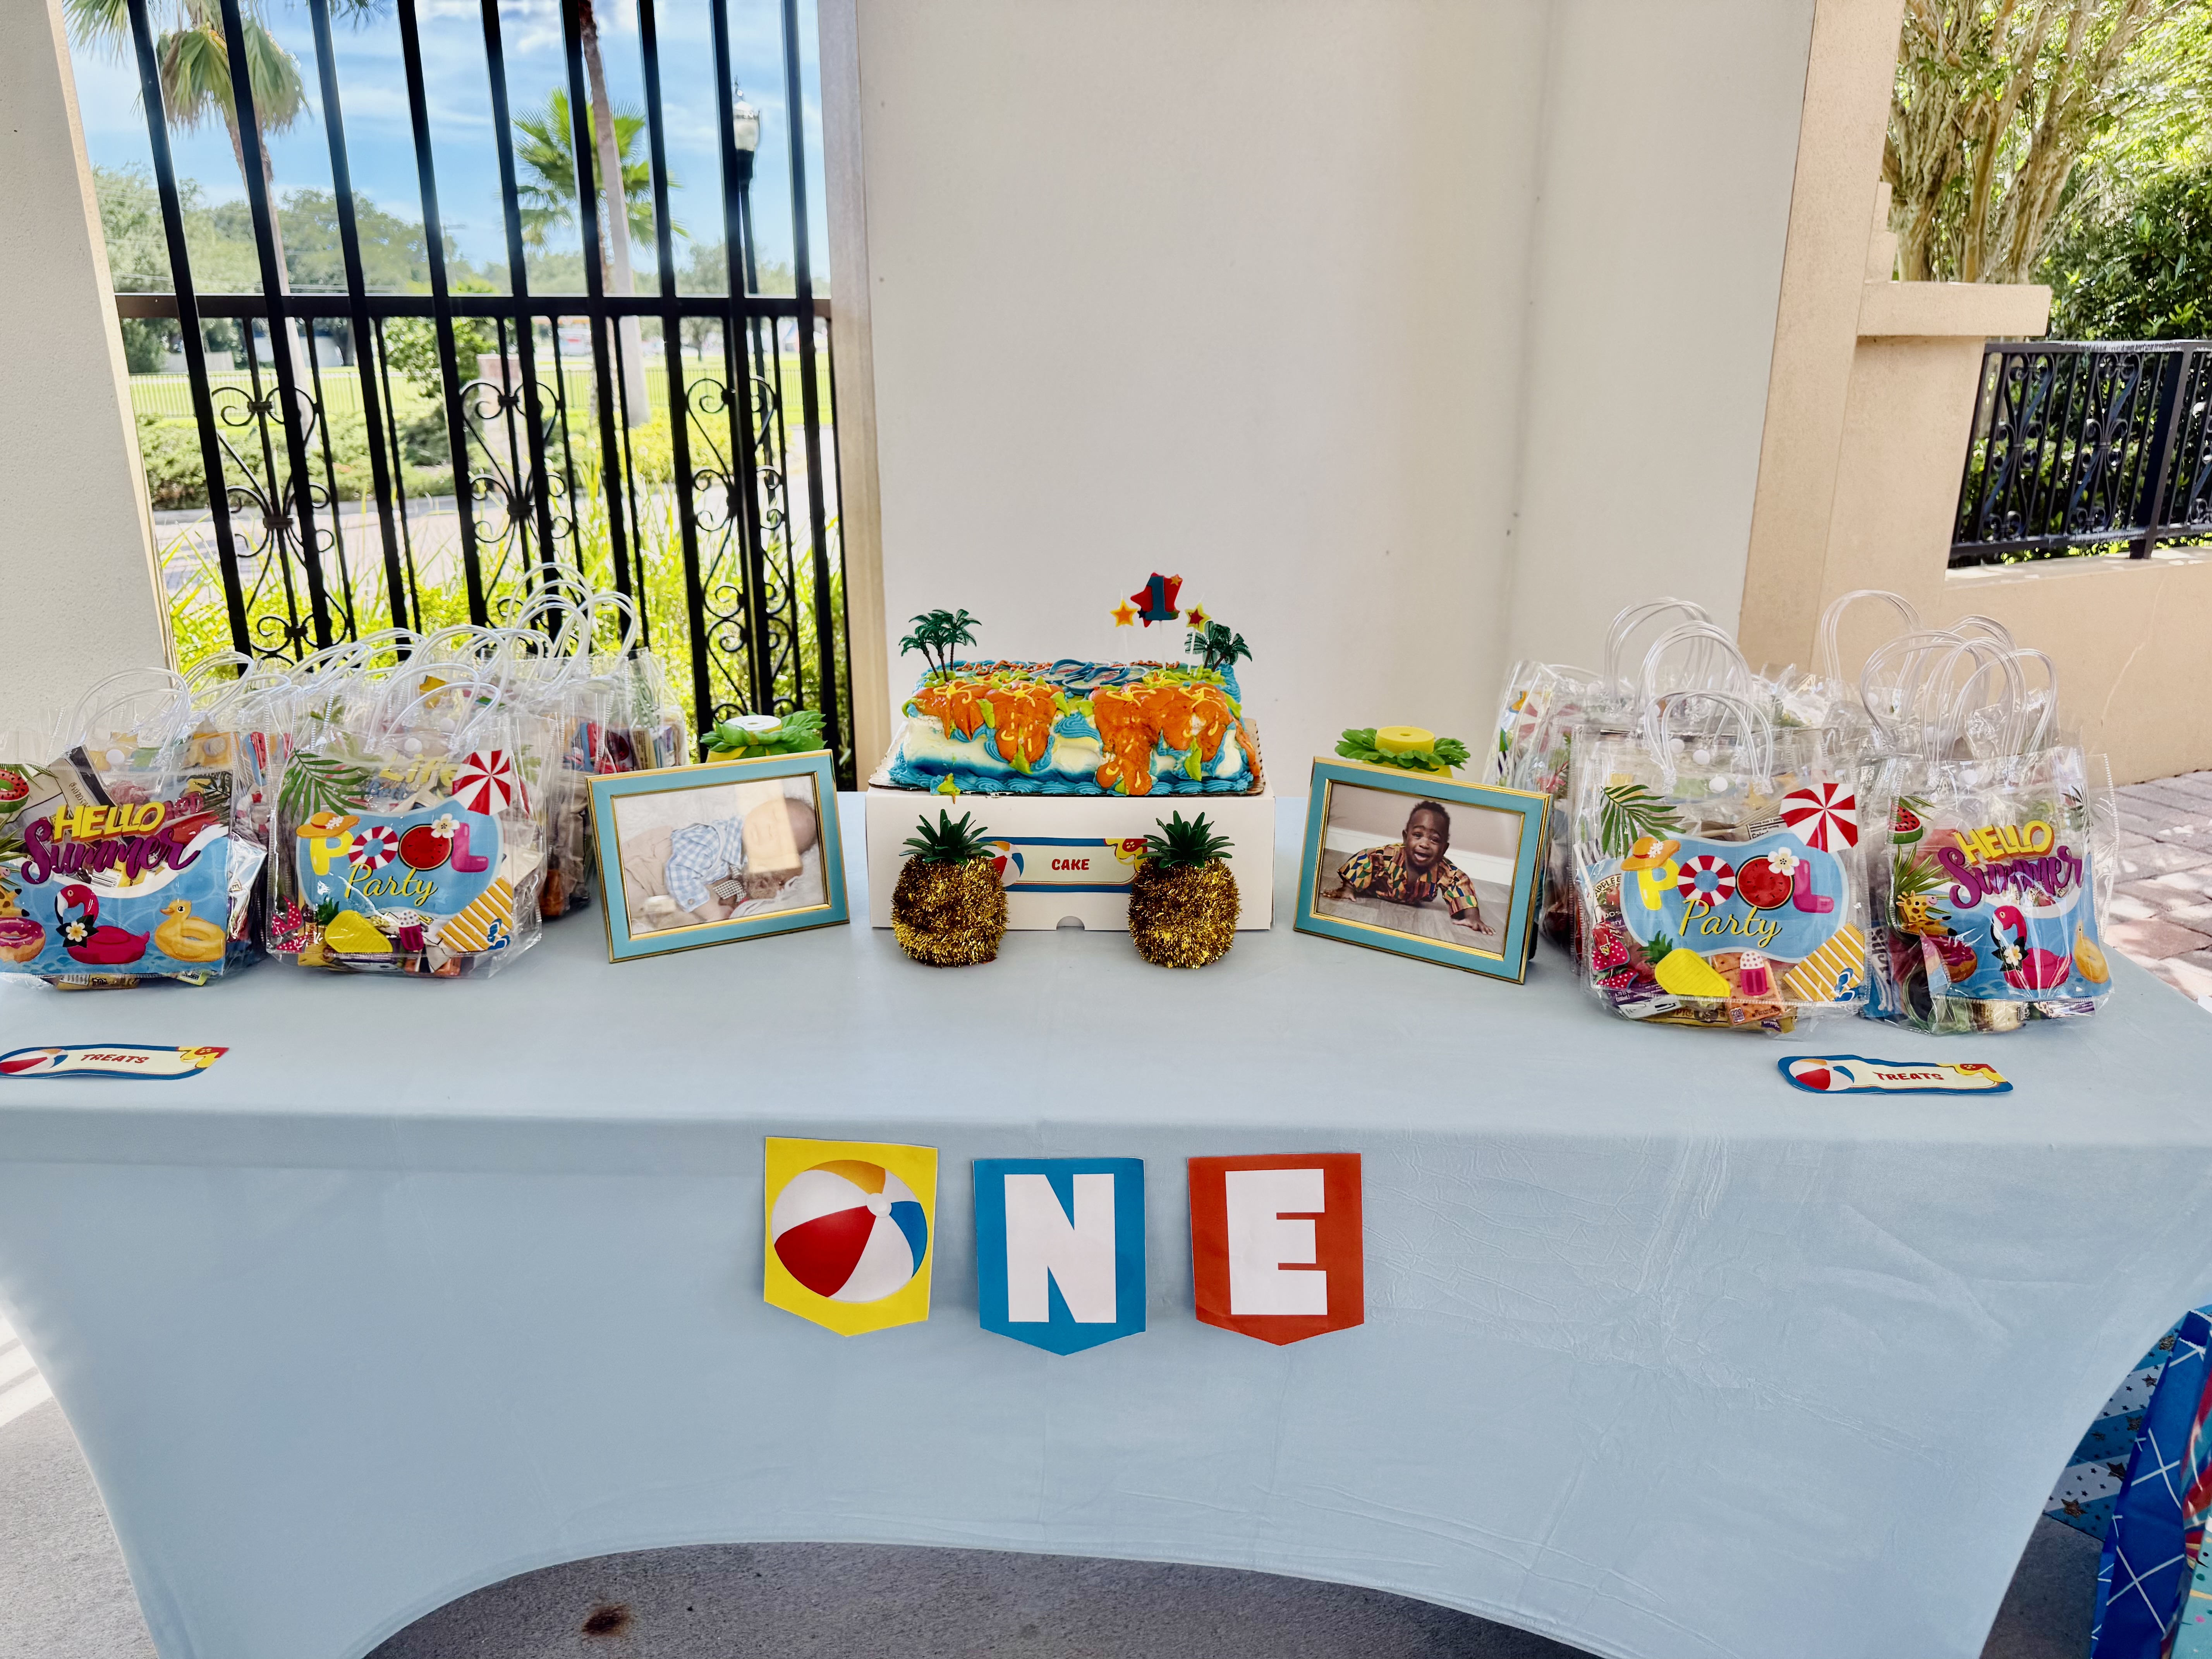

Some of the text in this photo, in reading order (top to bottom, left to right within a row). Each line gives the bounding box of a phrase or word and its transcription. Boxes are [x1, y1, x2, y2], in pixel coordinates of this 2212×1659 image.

[53, 801, 166, 843] HELLO
[1954, 820, 2054, 867] HELLO
[21, 816, 201, 885] Summer
[1051, 857, 1090, 871] CAKE
[343, 863, 438, 907] Party
[1595, 877, 1615, 897] APPLE
[1938, 845, 2083, 908] Summer
[1678, 898, 1783, 948] Party
[80, 1054, 150, 1064] TREATS
[1875, 1071, 1945, 1083] TREATS
